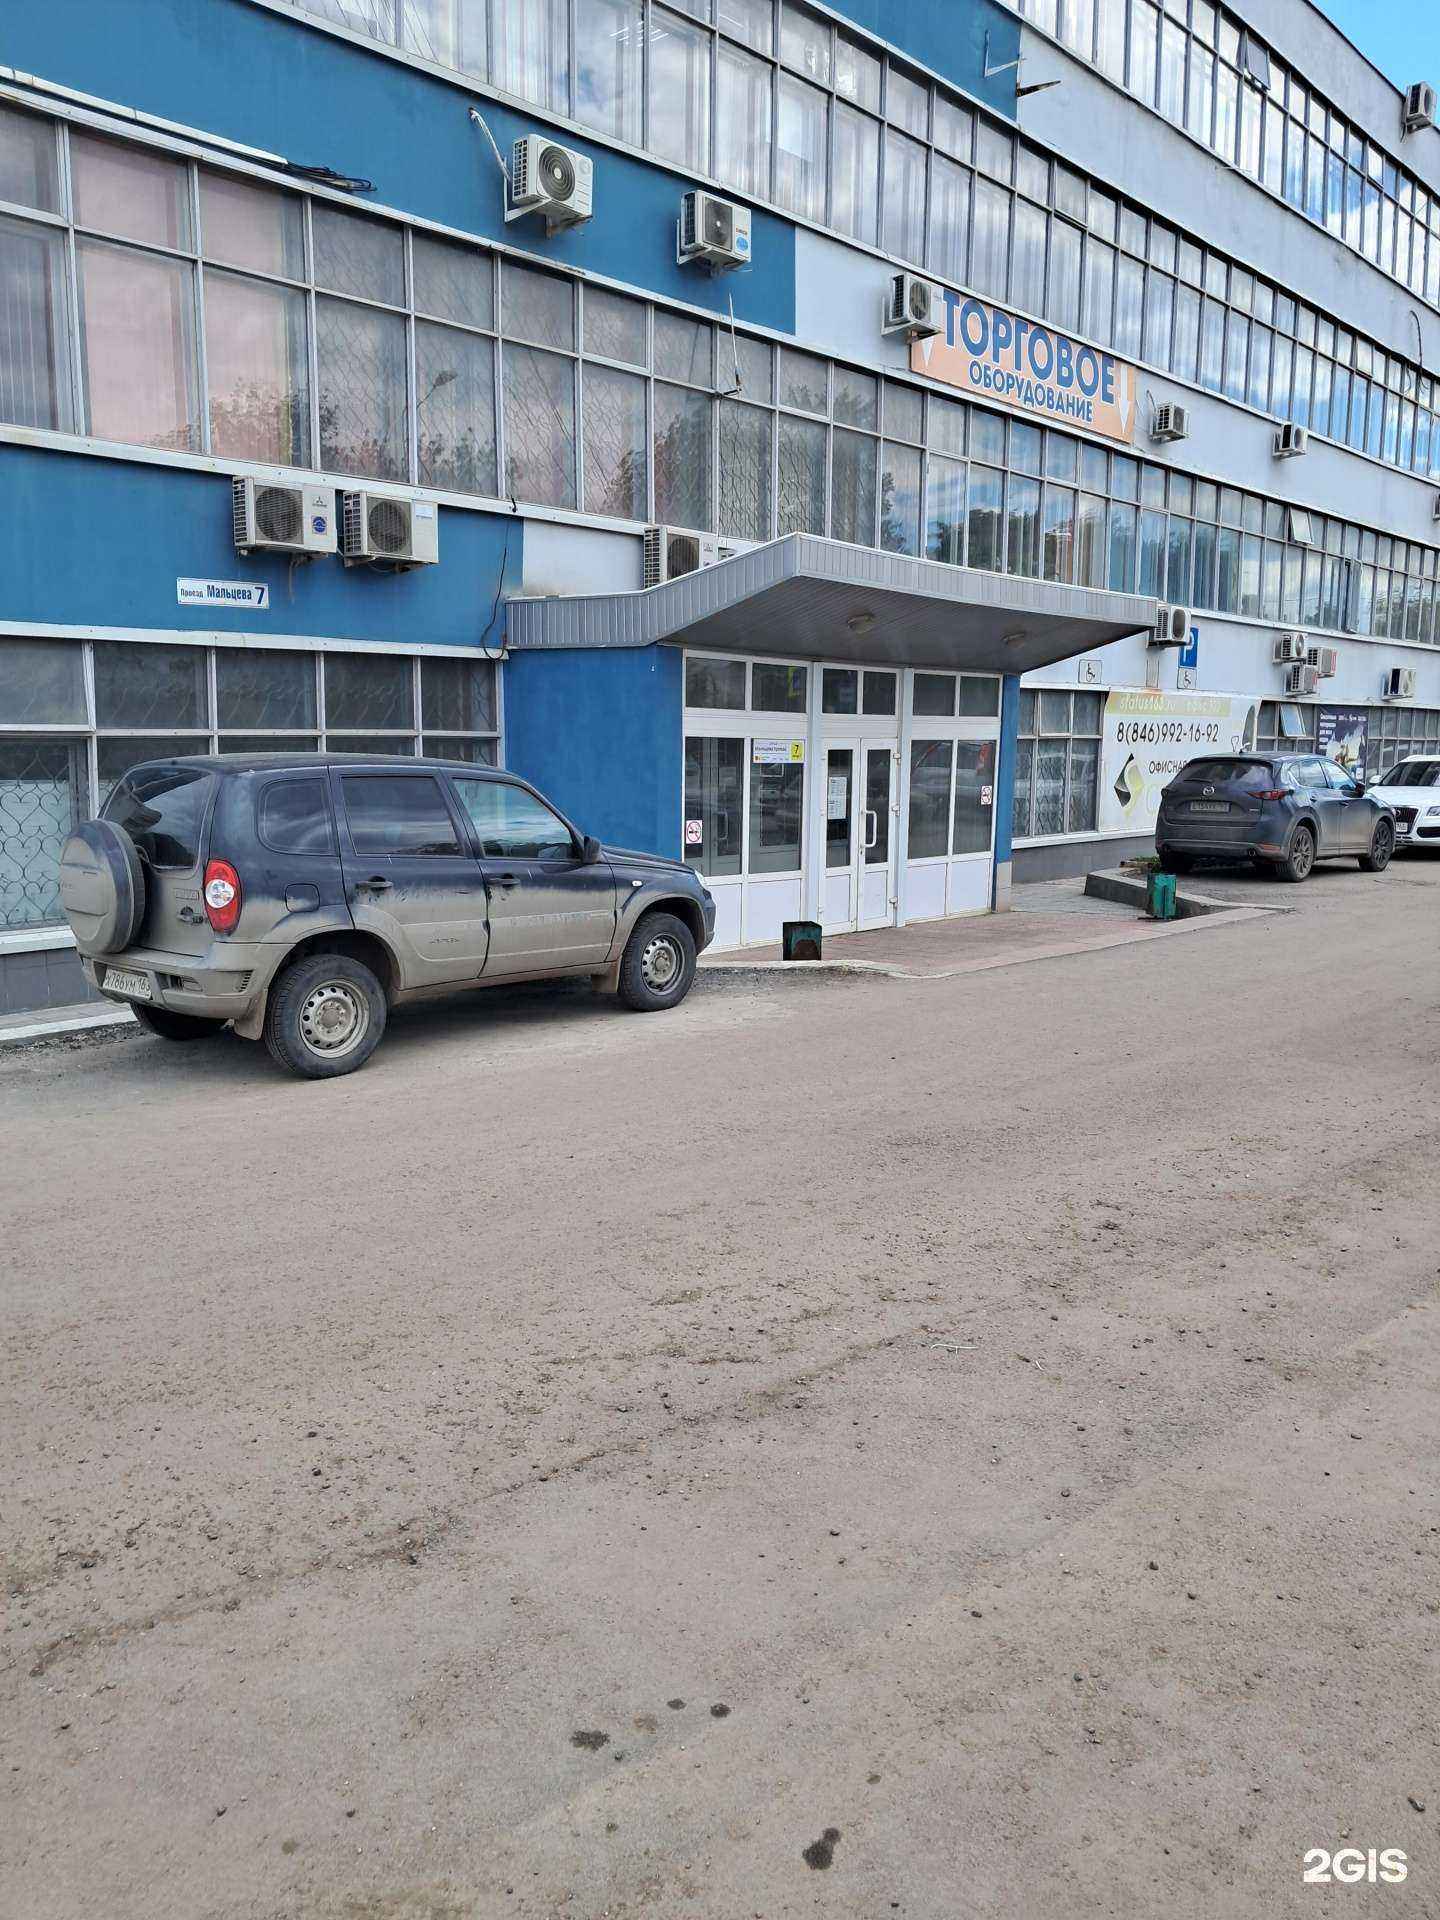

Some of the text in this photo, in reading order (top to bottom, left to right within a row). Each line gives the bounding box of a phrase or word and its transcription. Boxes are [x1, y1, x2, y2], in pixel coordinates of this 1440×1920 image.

[943, 289, 1116, 404] ТОРГОВОЕ
[969, 360, 1093, 423] ОБОРУДОВАНИЕ
[206, 584, 252, 600] Мальцева
[254, 586, 265, 605] 7
[1117, 721, 1219, 745] 8(846)992-16-92
